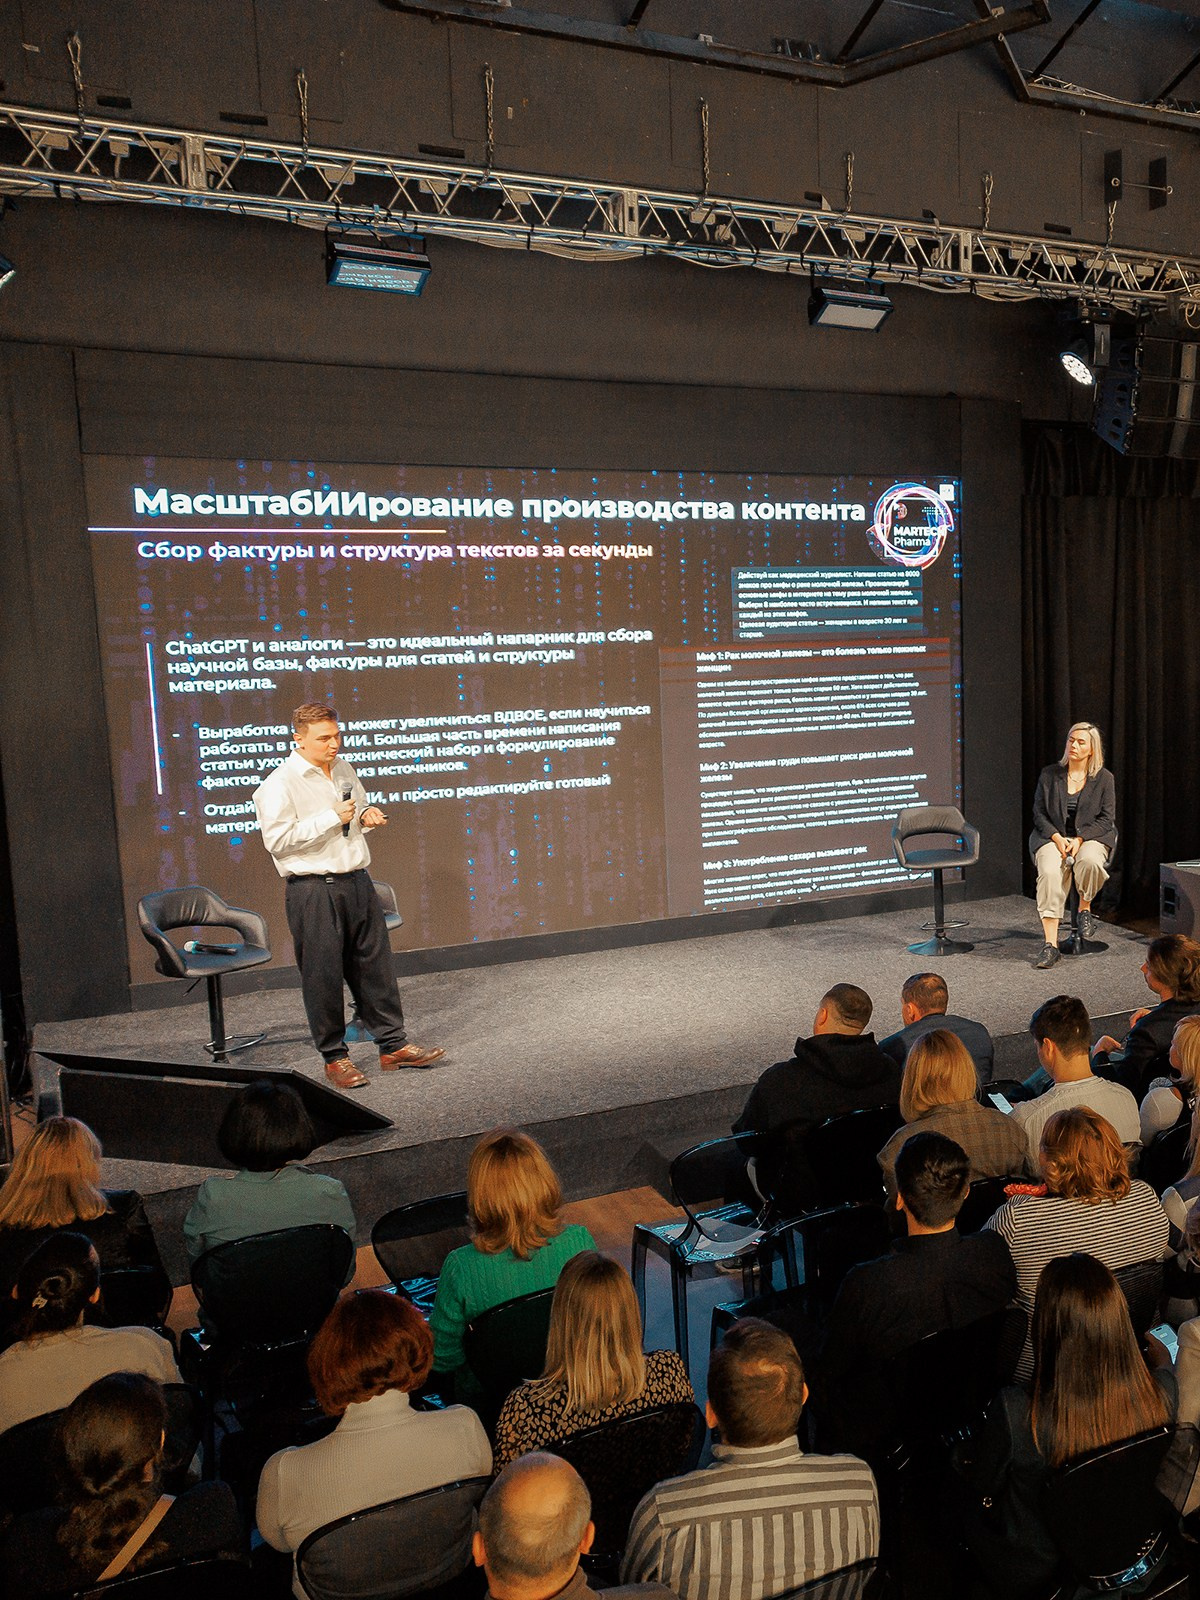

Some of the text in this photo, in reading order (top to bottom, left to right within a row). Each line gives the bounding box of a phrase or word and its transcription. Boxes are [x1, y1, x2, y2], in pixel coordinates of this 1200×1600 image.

[133, 487, 866, 524] МасштабИИрование производства контента
[893, 526, 946, 537] MARTECH
[893, 536, 931, 547] Pharma
[137, 540, 652, 564] Сбор фактуры и структура текстов за секунды
[165, 638, 249, 656] ChatGPT
[251, 640, 265, 653] и
[268, 638, 343, 653] аналоги
[367, 636, 397, 650] это
[399, 631, 493, 650] идеальный
[496, 631, 575, 647] напарник
[575, 630, 605, 645] для
[607, 627, 653, 644] сбора
[167, 648, 575, 677] научной базы, фактуры для статей и структуры
[168, 677, 277, 695] материала.
[198, 723, 289, 741] Выработка
[347, 718, 397, 731] может
[398, 713, 491, 731] увеличиться
[493, 708, 547, 725] ВДВОЕ,
[548, 708, 582, 720] если
[583, 704, 651, 720] научиться
[199, 740, 273, 759] работать
[275, 740, 286, 752] в
[343, 733, 371, 748] ИИ.
[373, 731, 440, 746] Большая
[441, 729, 482, 745] часть
[483, 725, 547, 743] времени
[547, 720, 621, 736] написания
[199, 758, 254, 772] статьи
[336, 745, 434, 763] технический
[436, 742, 481, 757] набор
[483, 740, 494, 753] и
[495, 734, 617, 755] формулирование
[355, 766, 377, 778] из
[377, 760, 469, 776] источников.
[388, 791, 399, 803] и
[401, 787, 454, 803] просто
[455, 778, 553, 800] редактируйте
[555, 773, 611, 790] готовый
